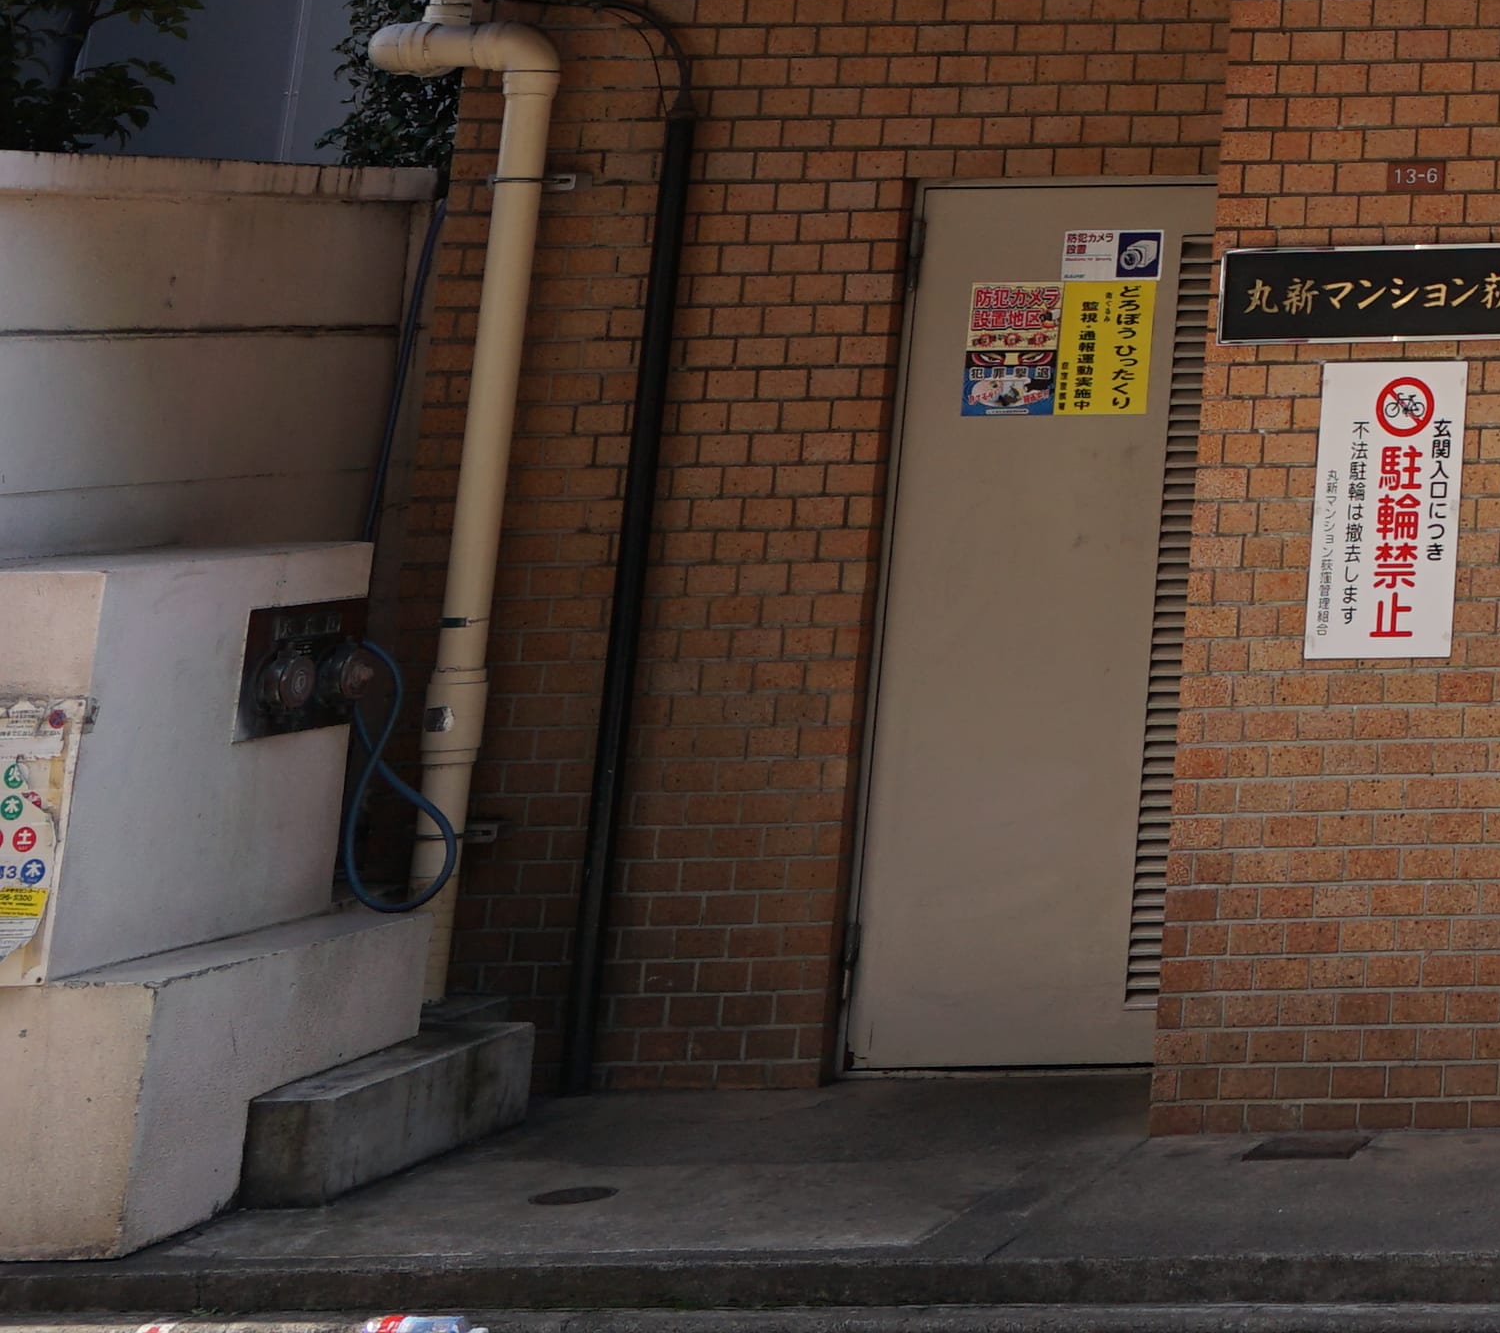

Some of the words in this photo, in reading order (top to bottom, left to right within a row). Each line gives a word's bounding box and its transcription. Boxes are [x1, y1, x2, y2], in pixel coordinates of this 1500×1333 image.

[1394, 167, 1439, 185] 13-6
[1066, 232, 1114, 244] 防犯カメラ
[1065, 244, 1087, 255] 設置
[975, 289, 1061, 308] 防犯カメラ
[972, 309, 1042, 331] 設置地区
[970, 366, 1051, 380] 犯罪撃退
[1426, 418, 1453, 562] 玄関入口につき
[1340, 420, 1371, 626] 不法駐輪は撤去します
[1368, 444, 1424, 639] 駐輪禁止
[1316, 469, 1341, 637] 丸新マンション荻窪管理組合
[16, 829, 32, 846] 土
